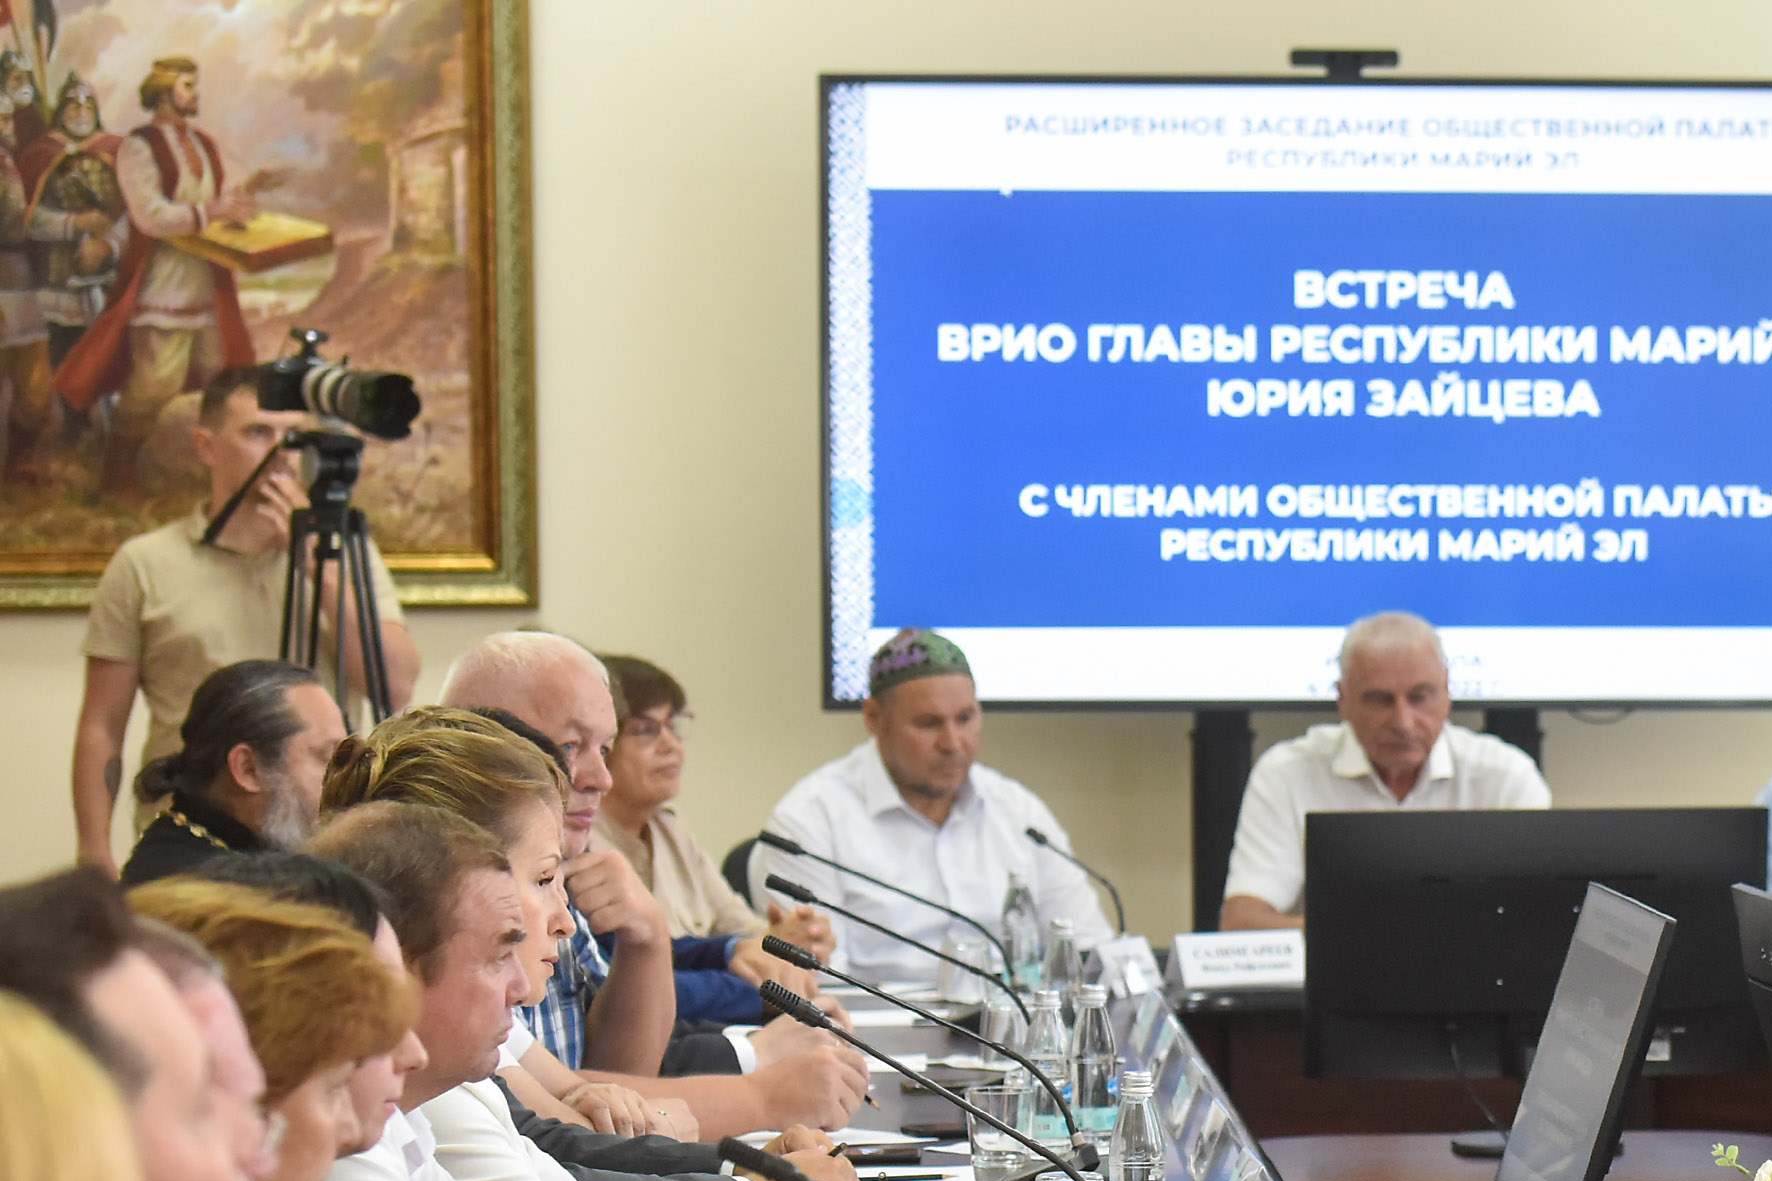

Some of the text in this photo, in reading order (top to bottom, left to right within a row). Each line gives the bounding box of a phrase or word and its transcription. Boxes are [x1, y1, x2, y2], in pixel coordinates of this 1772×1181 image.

[1005, 115, 1228, 136] РАСШИРЕННОЕ
[1241, 117, 1412, 138] ЗАСЕДАНИЕ
[1422, 114, 1666, 138] ОБЩЕСТВЕННОЙ
[1227, 149, 1419, 168] РЕСПУБЛИКИ
[1430, 148, 1533, 169] МАРИЙ
[1294, 271, 1515, 310] ВСТРЕЧА
[938, 324, 1077, 363] ВРИО
[1088, 325, 1258, 363] ГЛАВЫ
[1271, 325, 1598, 364] РЕСПУБЛИКИ
[1208, 373, 1601, 424] ЮРИЯ ЗАЙЦЕВА
[1019, 484, 1047, 517] С
[1056, 484, 1259, 518] ЧЛЕНАМИ
[1267, 479, 1605, 525] ОБЩЕСТВЕННОЙ
[1161, 524, 1648, 563] РЕСПУБЛИКИ МАРИЙ ЭЛ
